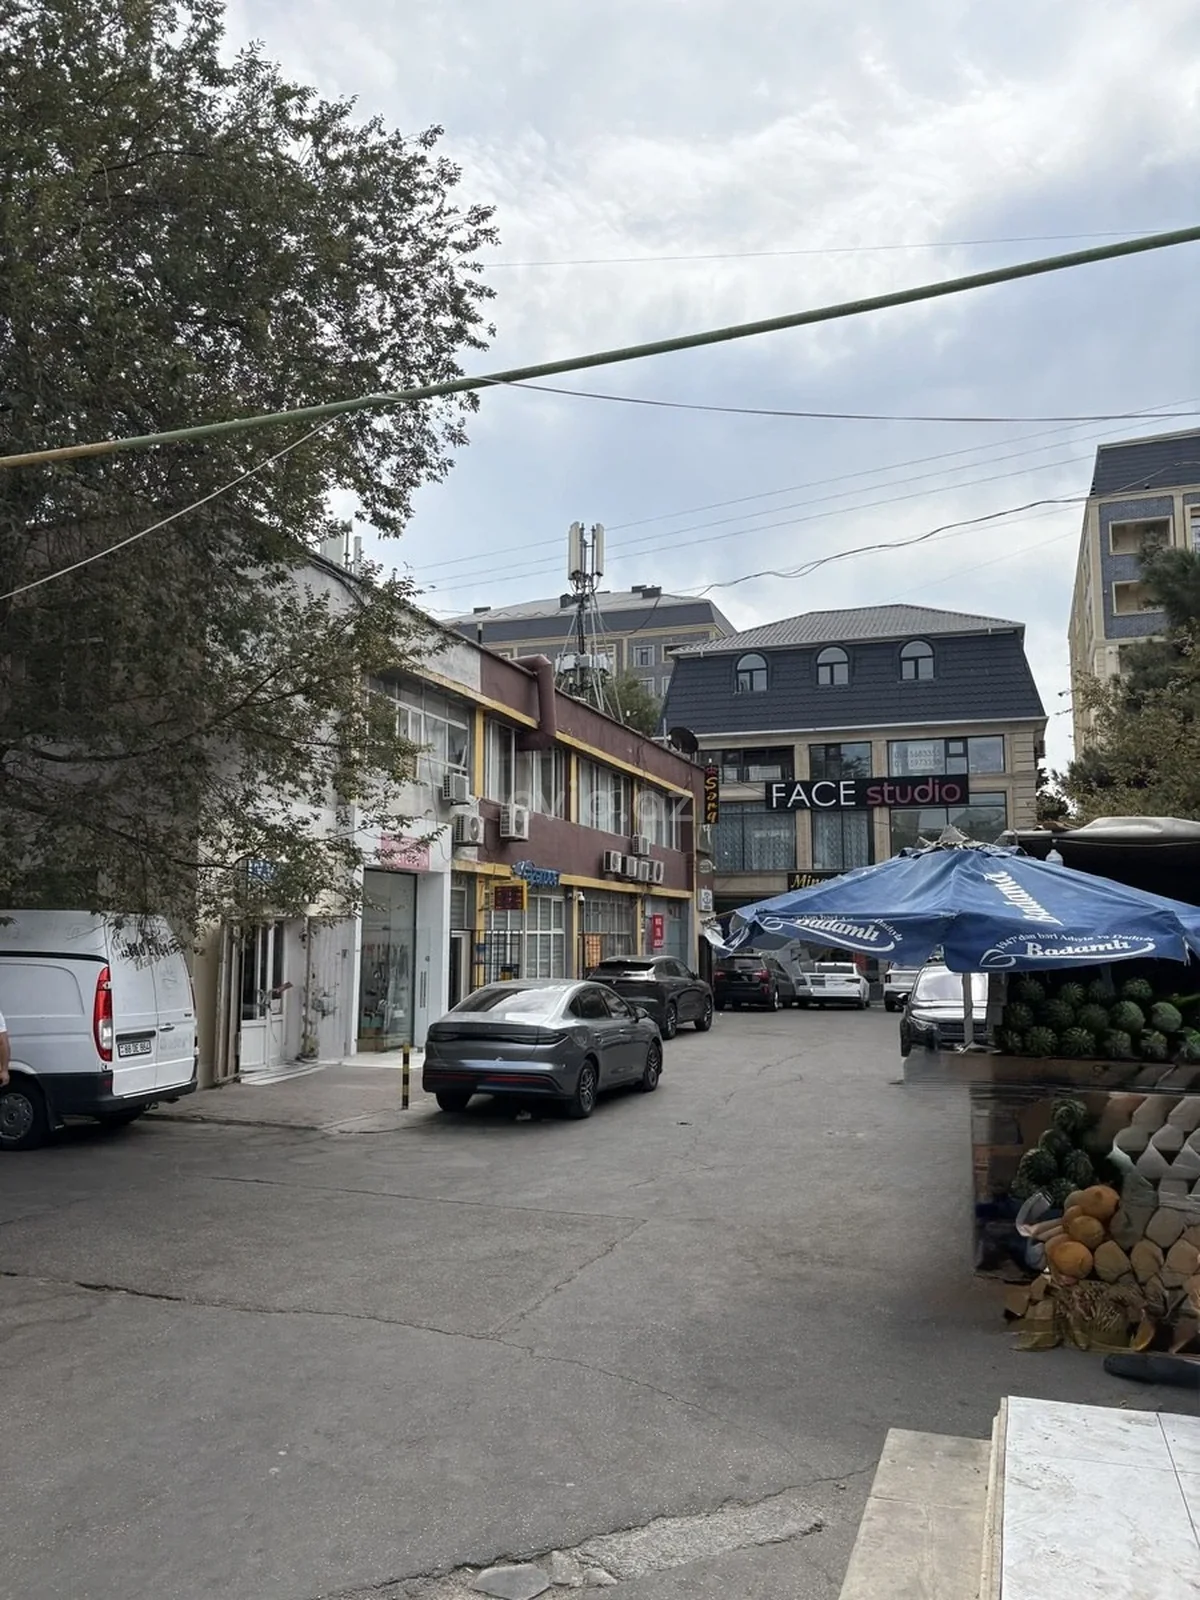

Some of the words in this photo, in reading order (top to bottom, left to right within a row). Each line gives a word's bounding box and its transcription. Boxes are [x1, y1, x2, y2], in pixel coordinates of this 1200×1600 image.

[772, 781, 855, 808] FACE
[867, 778, 961, 804] studio
[1025, 939, 1132, 957] Badamlı
